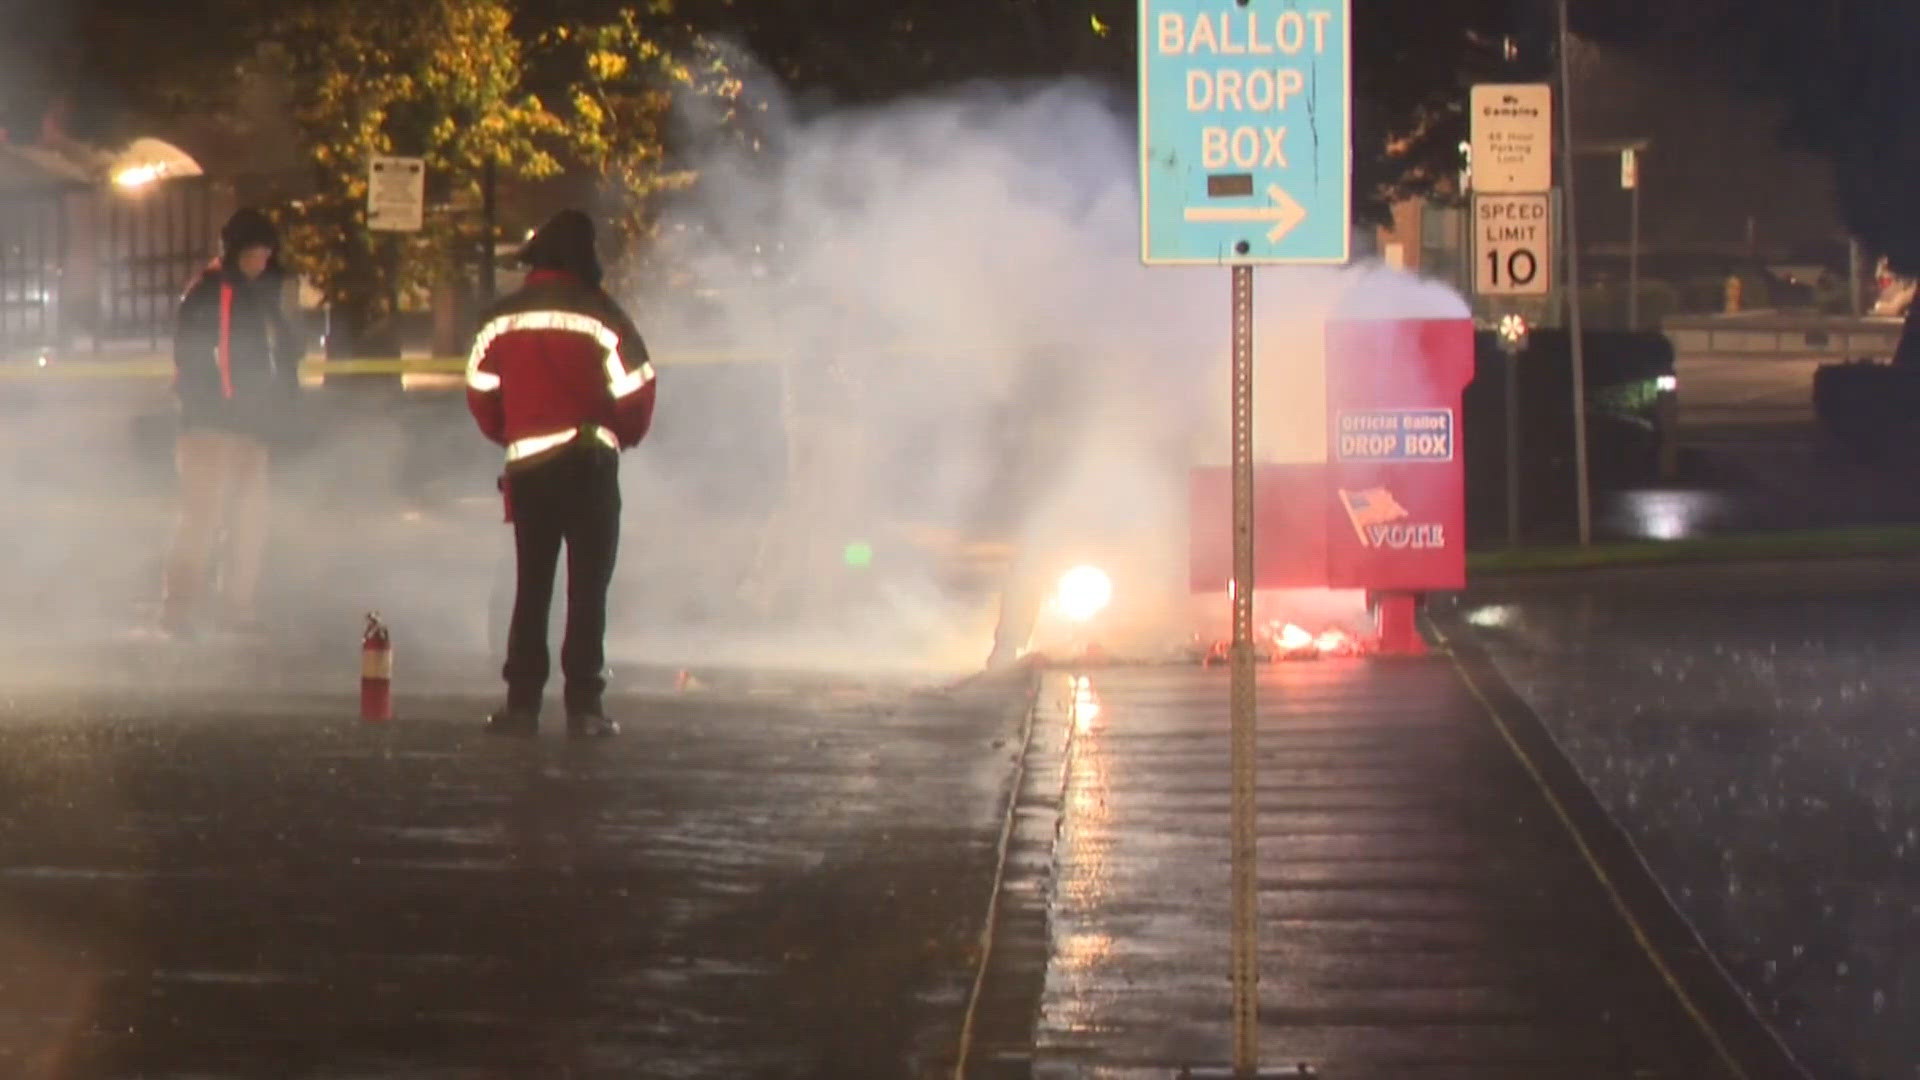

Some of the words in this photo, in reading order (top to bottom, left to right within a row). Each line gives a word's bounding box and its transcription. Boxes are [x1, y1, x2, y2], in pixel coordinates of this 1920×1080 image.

[1158, 11, 1331, 54] BALLOT
[1186, 69, 1303, 111] DROP
[1483, 107, 1538, 117] Camping
[1202, 126, 1289, 169] BOX
[1490, 143, 1531, 154] Parking
[1481, 204, 1544, 219] SPEED
[1487, 226, 1535, 240] LIMIT
[1487, 248, 1537, 286] 10
[1342, 416, 1397, 430] Official
[1403, 416, 1447, 430] Ballot
[1342, 434, 1397, 456] DROP
[1405, 434, 1447, 456] BOX
[1368, 523, 1445, 548] VOTE
